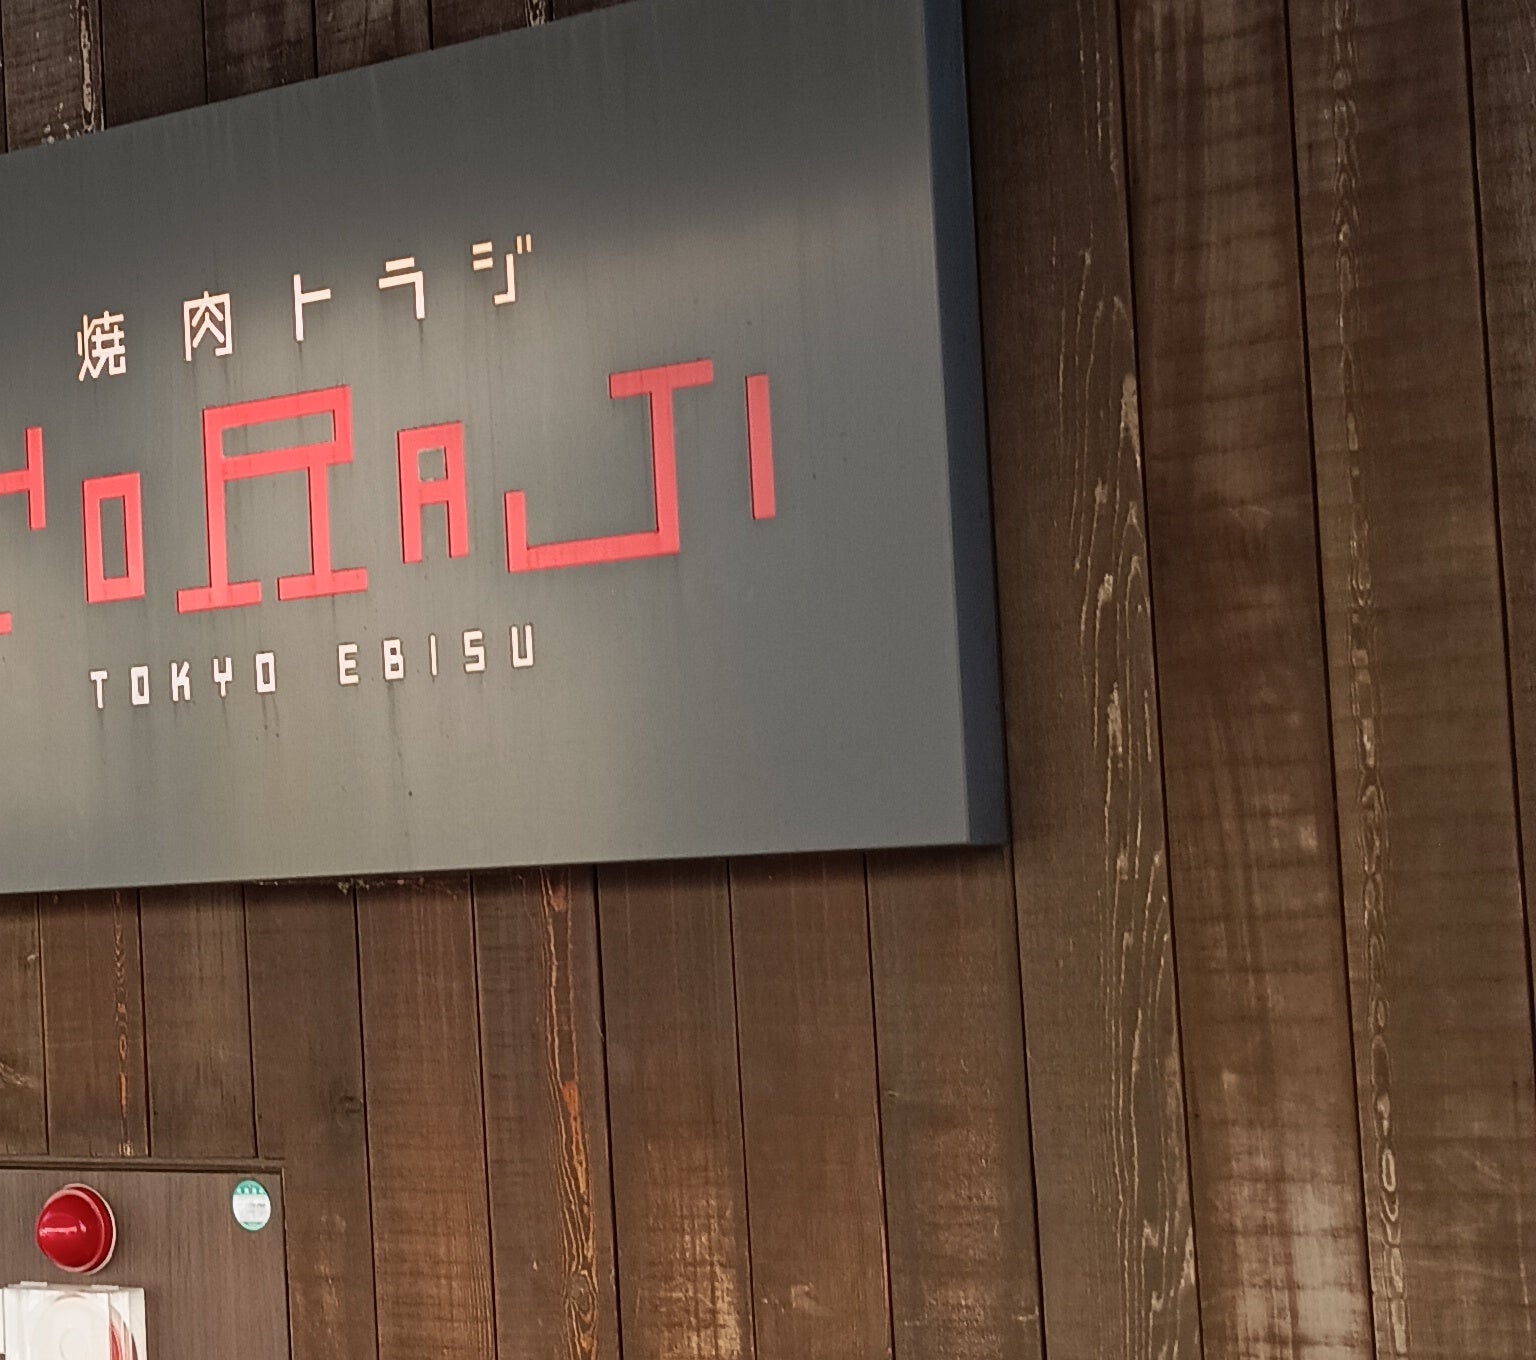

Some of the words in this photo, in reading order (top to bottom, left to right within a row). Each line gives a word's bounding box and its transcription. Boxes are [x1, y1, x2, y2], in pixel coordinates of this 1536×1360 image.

[77, 234, 534, 382] 焼肉トラジ
[90, 652, 276, 709] TOKYO
[338, 624, 535, 685] EBISU
